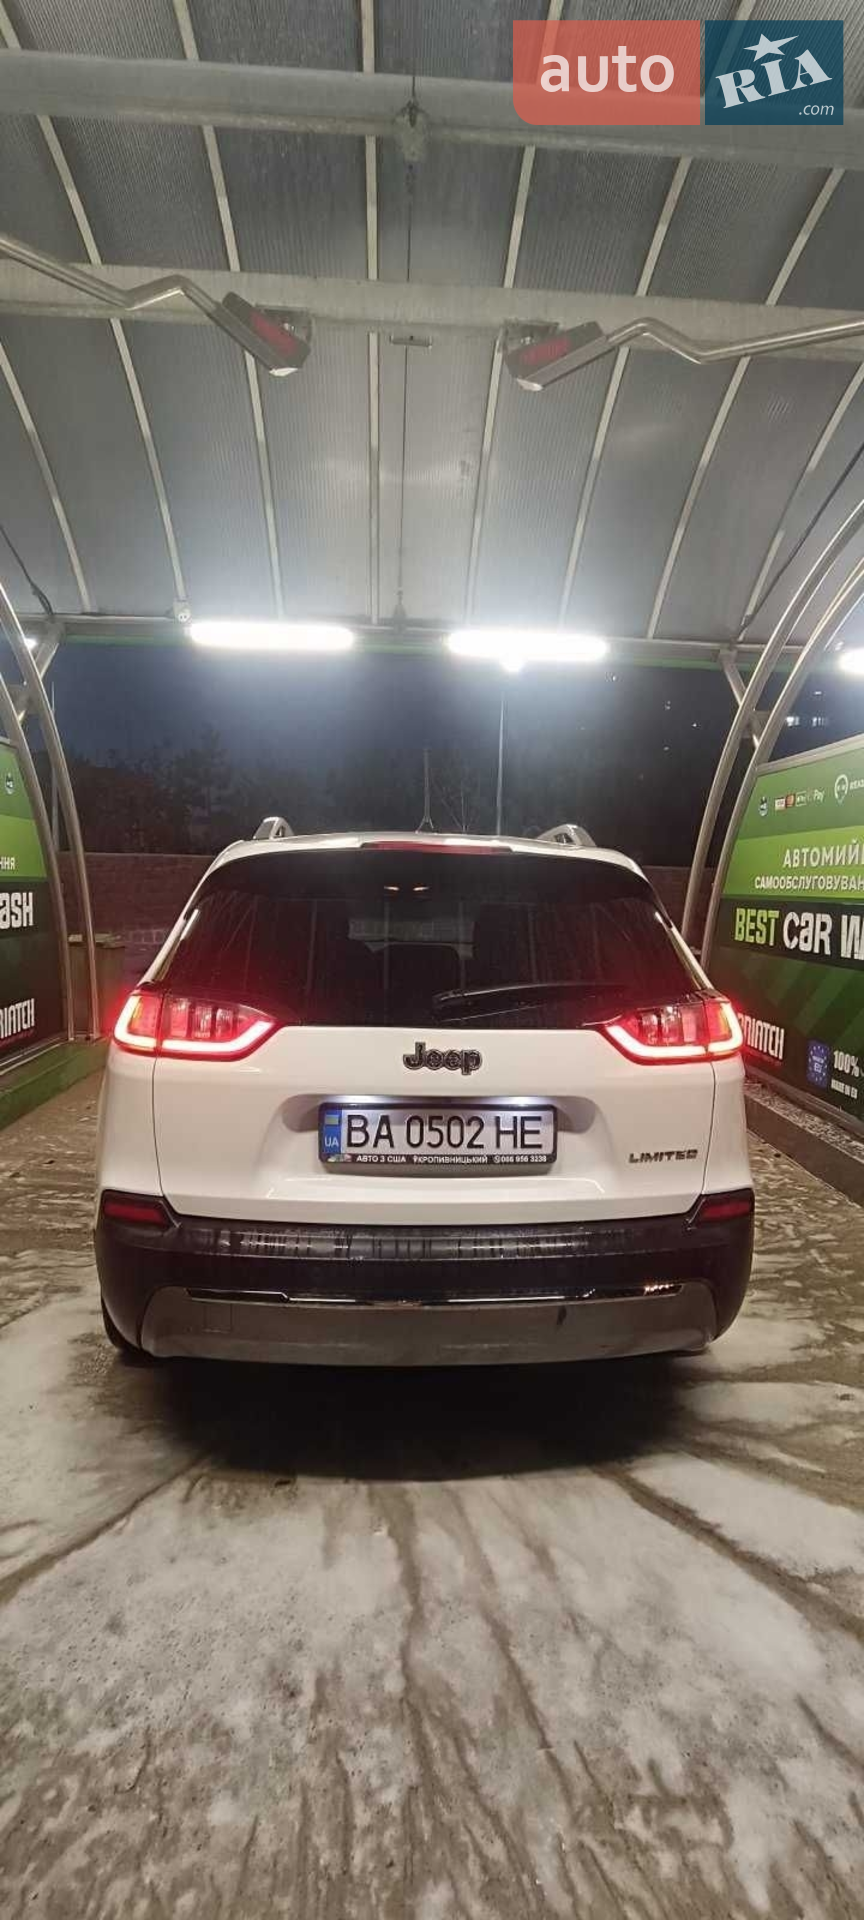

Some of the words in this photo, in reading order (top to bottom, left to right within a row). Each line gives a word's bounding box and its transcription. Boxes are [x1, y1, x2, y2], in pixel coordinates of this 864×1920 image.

[783, 839, 864, 868] АВТОМИЙ
[734, 907, 780, 947] BEST
[403, 1041, 483, 1076] Jeep
[324, 1138, 339, 1148] UA
[406, 1115, 484, 1149] 0502
[629, 1149, 698, 1163] LIMITED
